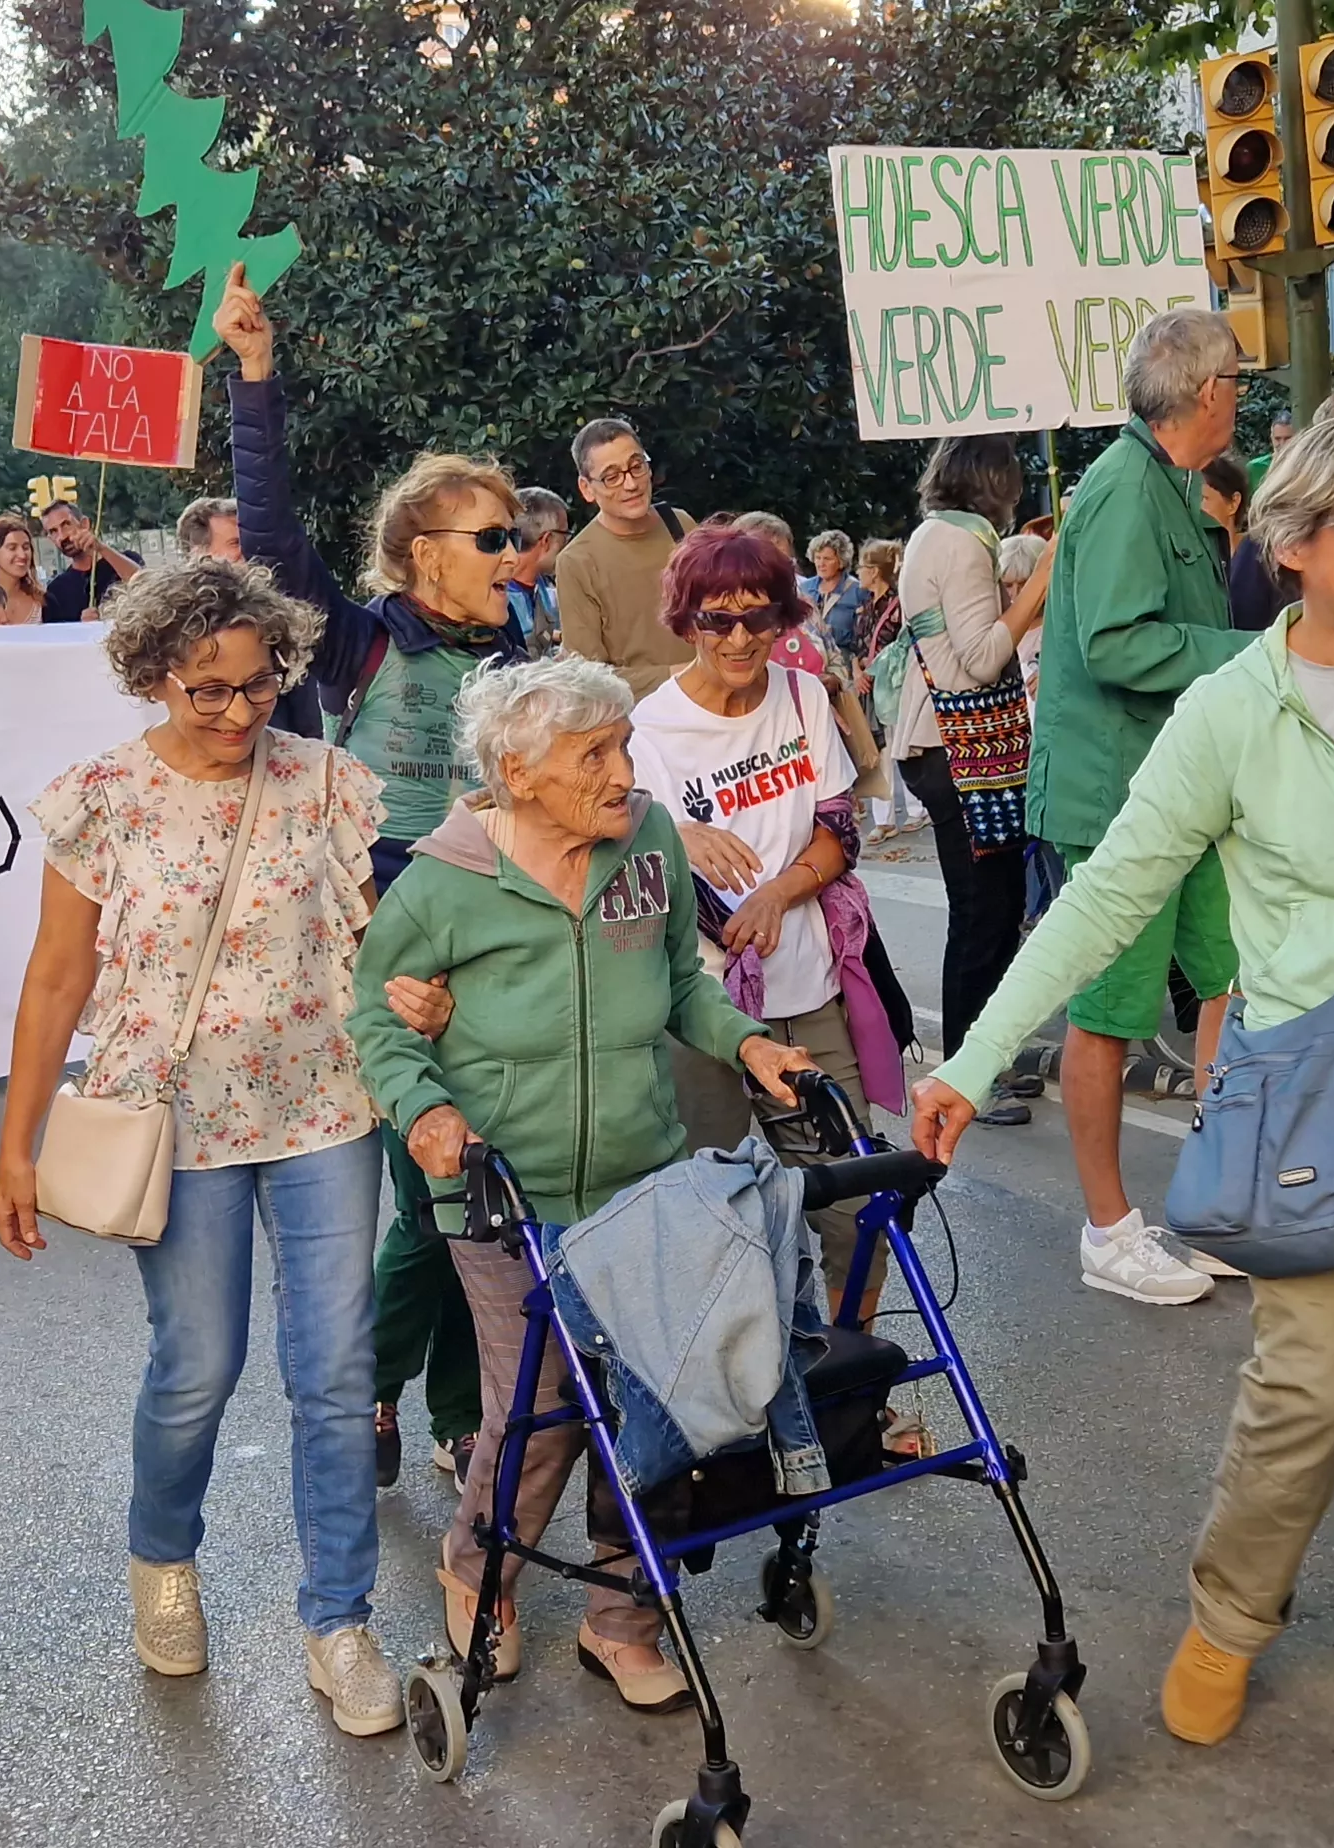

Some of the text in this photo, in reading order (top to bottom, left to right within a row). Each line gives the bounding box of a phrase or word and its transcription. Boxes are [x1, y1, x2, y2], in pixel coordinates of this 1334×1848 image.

[840, 154, 1203, 273] HUESCA VERDE
[89, 349, 134, 382] NO
[849, 295, 1195, 427] VERDE, VER
[66, 381, 140, 414] A LA
[59, 408, 152, 456] TALA
[710, 751, 774, 788] HUESCA
